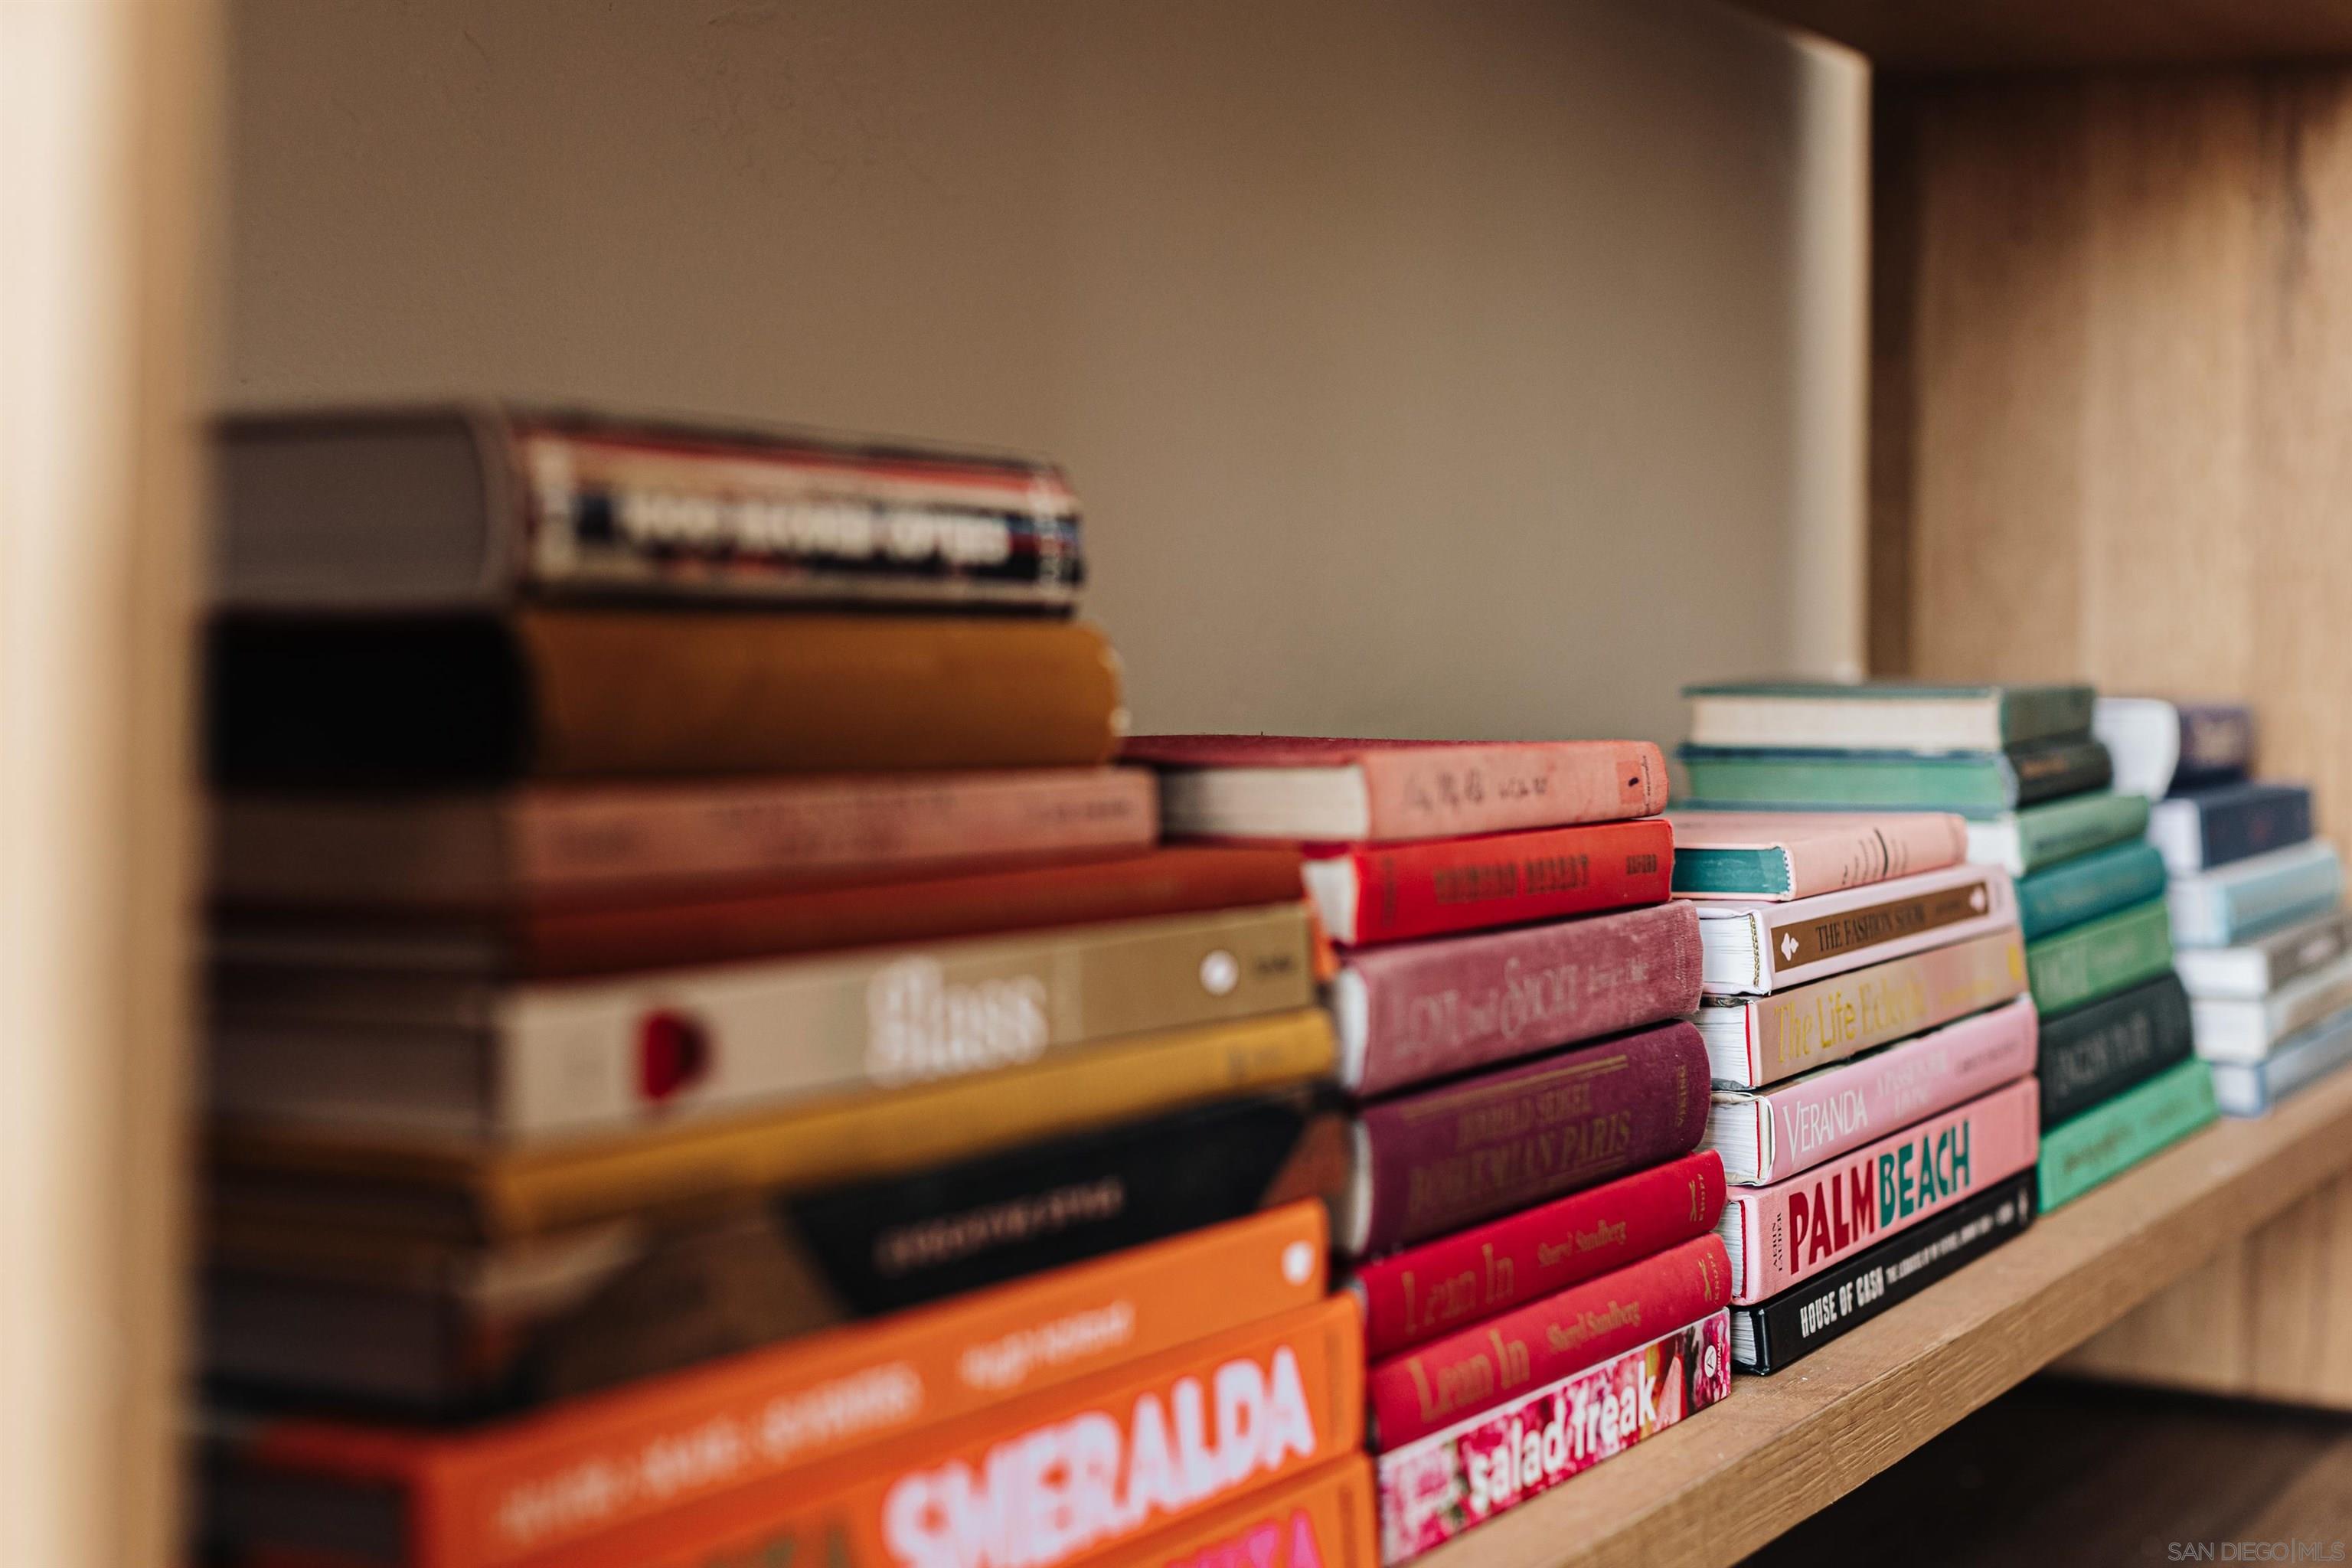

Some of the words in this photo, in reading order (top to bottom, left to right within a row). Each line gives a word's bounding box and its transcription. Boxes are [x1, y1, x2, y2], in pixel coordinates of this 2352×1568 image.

[1815, 922, 1844, 952] THE
[1773, 999, 1813, 1063] The
[1817, 991, 1857, 1049] Life
[1560, 1109, 1632, 1171] PARIS
[1782, 1088, 1868, 1165] VERANDA
[1800, 1291, 1838, 1338] HOUSE
[1839, 1282, 1854, 1317] OF
[1856, 1266, 1885, 1308] CASH
[880, 1344, 1315, 1568] SMERALDA
[1469, 1396, 1568, 1514] salad
[1570, 1360, 1657, 1461] freak
